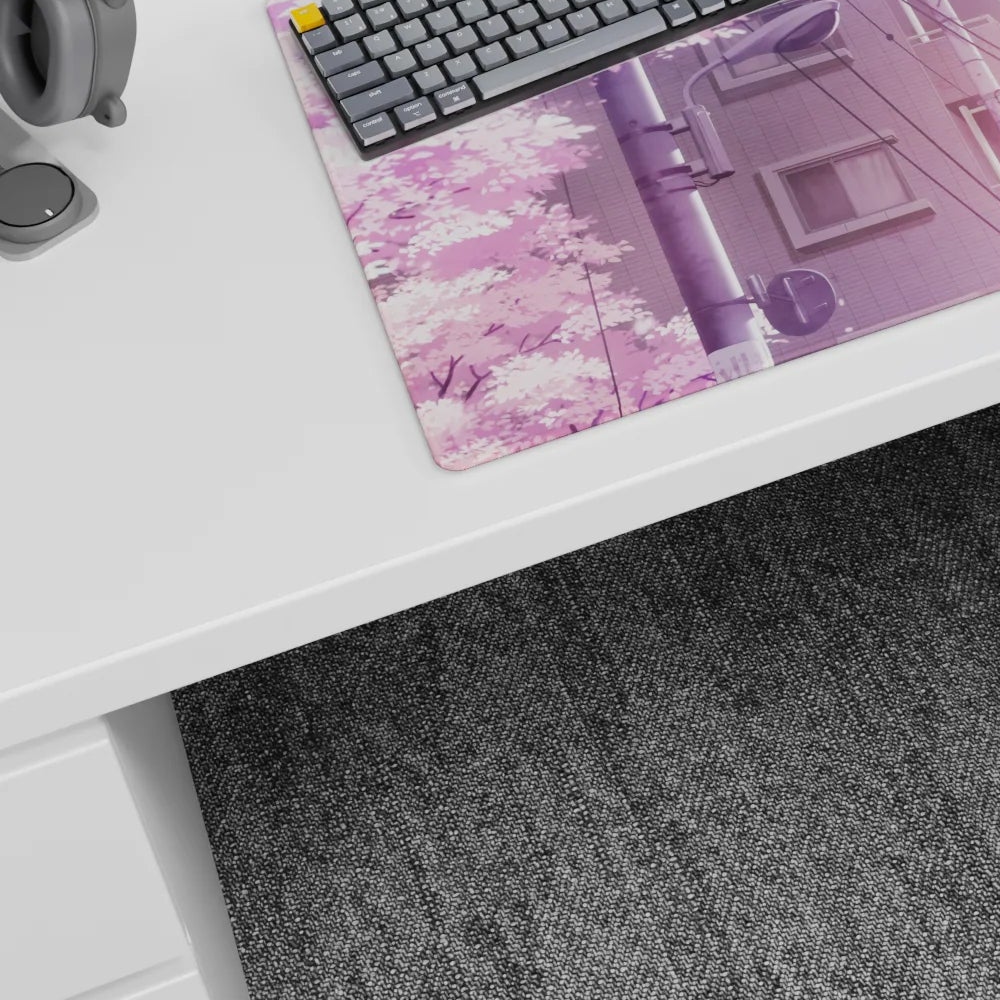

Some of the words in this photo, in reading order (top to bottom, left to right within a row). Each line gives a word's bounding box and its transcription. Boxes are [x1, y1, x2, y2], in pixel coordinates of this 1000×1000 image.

[438, 84, 466, 99] command
[403, 102, 423, 113] option
[362, 117, 383, 128] control
